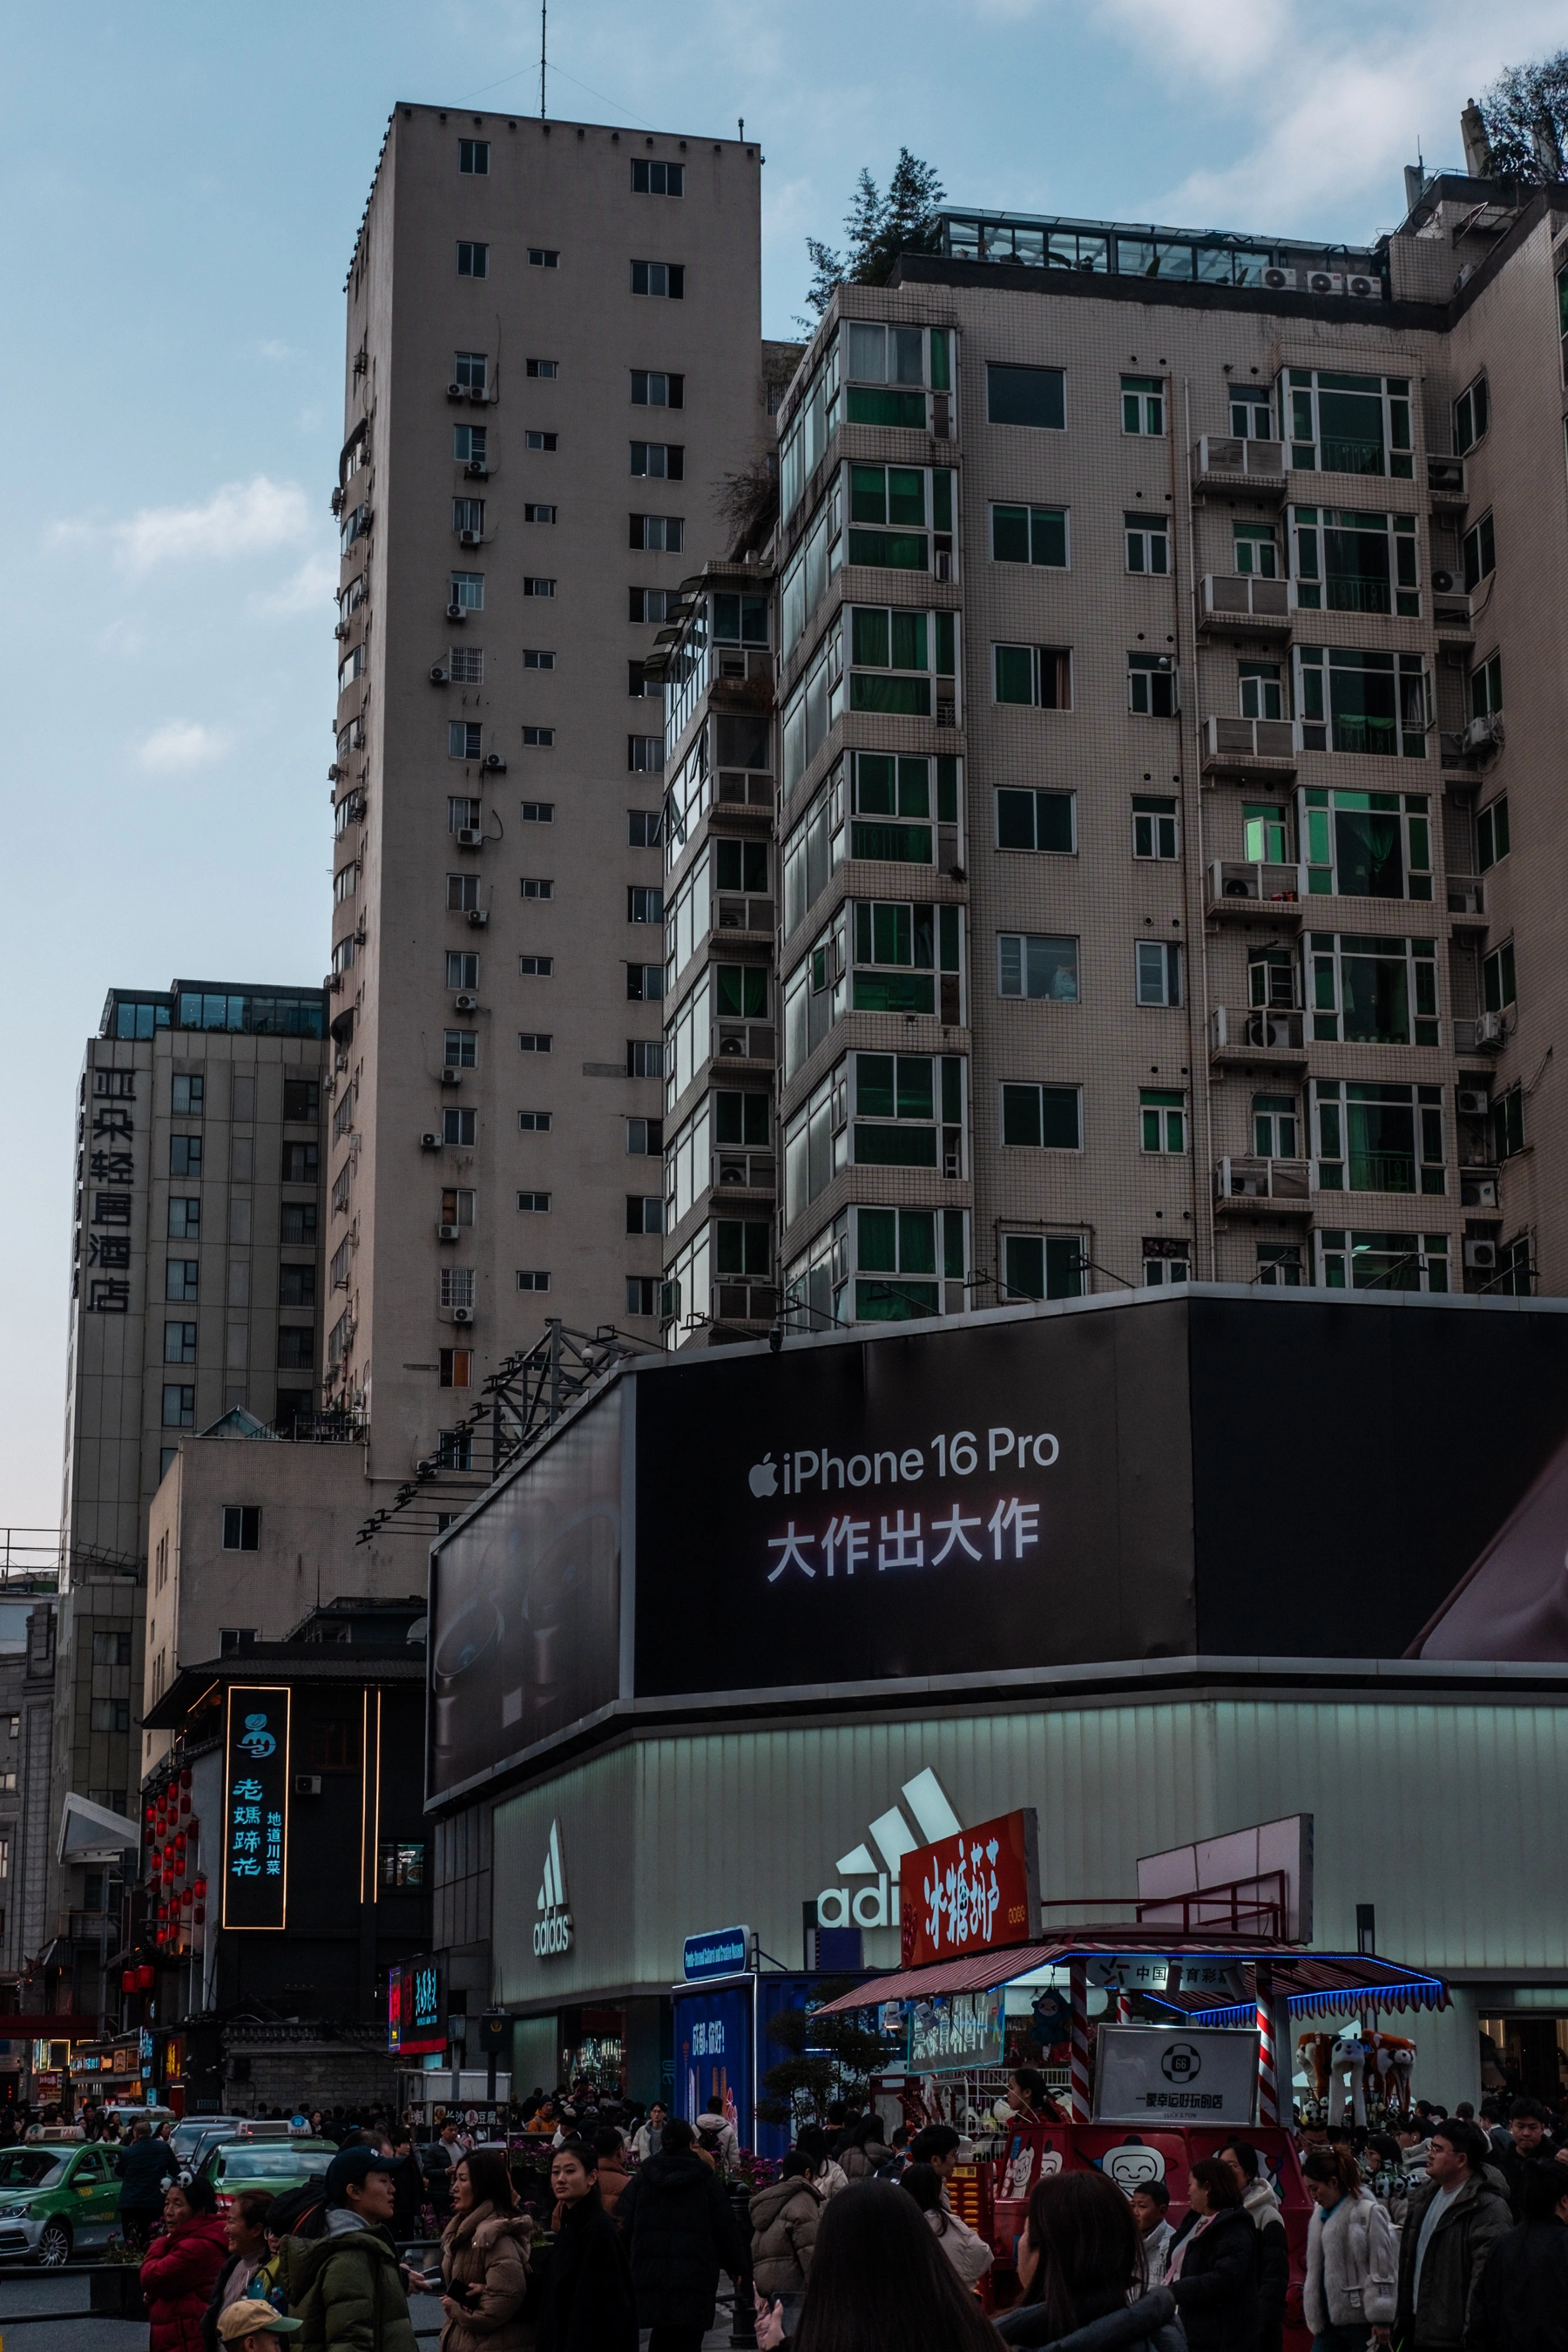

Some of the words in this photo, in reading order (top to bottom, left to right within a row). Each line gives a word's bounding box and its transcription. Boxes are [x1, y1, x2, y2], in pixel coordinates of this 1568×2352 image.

[88, 1067, 136, 1312] 亚朵轻居酒店
[783, 1448, 924, 1495] iPhone
[930, 1430, 978, 1477] 16
[989, 1427, 1059, 1471] Pro
[767, 1497, 1040, 1583] 大作出大作
[231, 1778, 263, 1876] 老媽蹄花
[266, 1811, 282, 1876] 地道川菜
[817, 1873, 901, 1928] adi
[924, 1837, 999, 1950] 冰糖葫芦
[533, 1907, 571, 1957] adidas
[1136, 1965, 1227, 1984] 中国育彩
[1175, 2058, 1187, 2070] 66
[1136, 2092, 1223, 2109] 一家幸运好玩的店
[62, 2129, 78, 2138] TAXI
